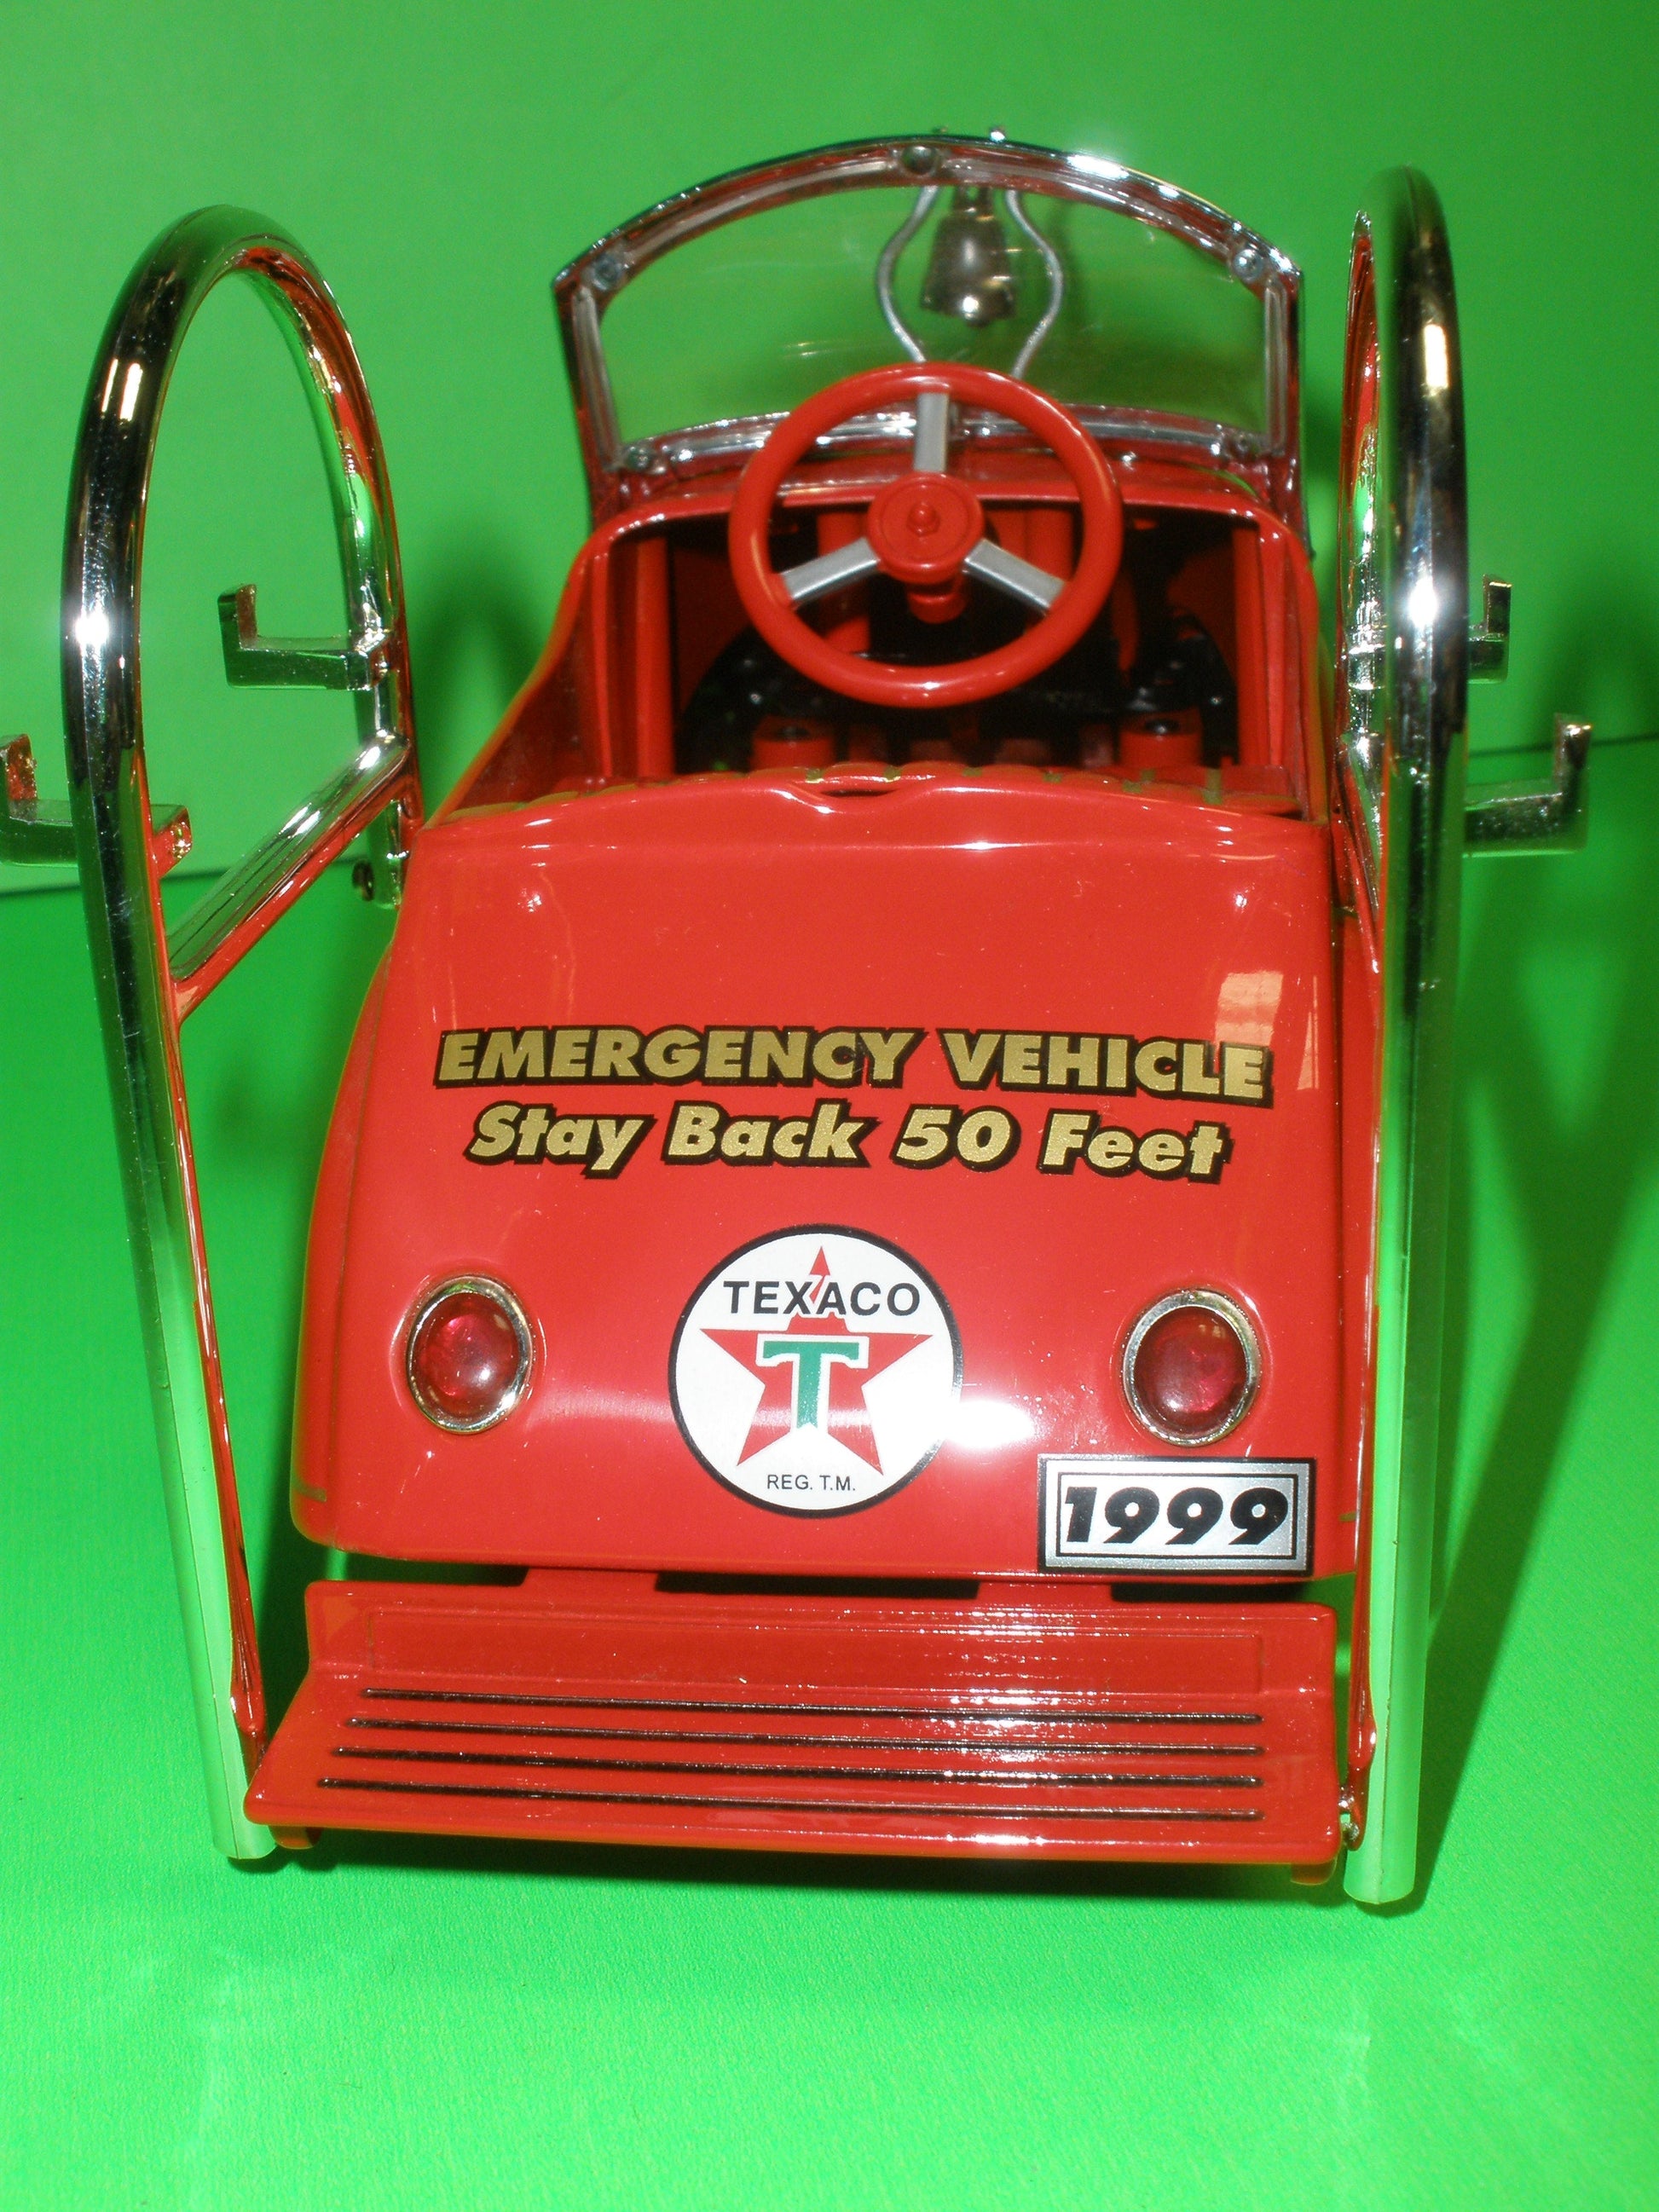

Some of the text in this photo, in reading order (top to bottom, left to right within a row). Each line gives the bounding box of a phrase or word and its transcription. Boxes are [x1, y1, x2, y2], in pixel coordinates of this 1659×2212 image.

[433, 1025, 1274, 1109] EMERGENCY VEHICLE
[463, 1099, 1234, 1184] Stay Back 50 Feet
[723, 1280, 920, 1316] TEXACO
[763, 1340, 860, 1429] T
[766, 1474, 856, 1492] REG. T.M.
[1065, 1486, 1288, 1545] 1999
